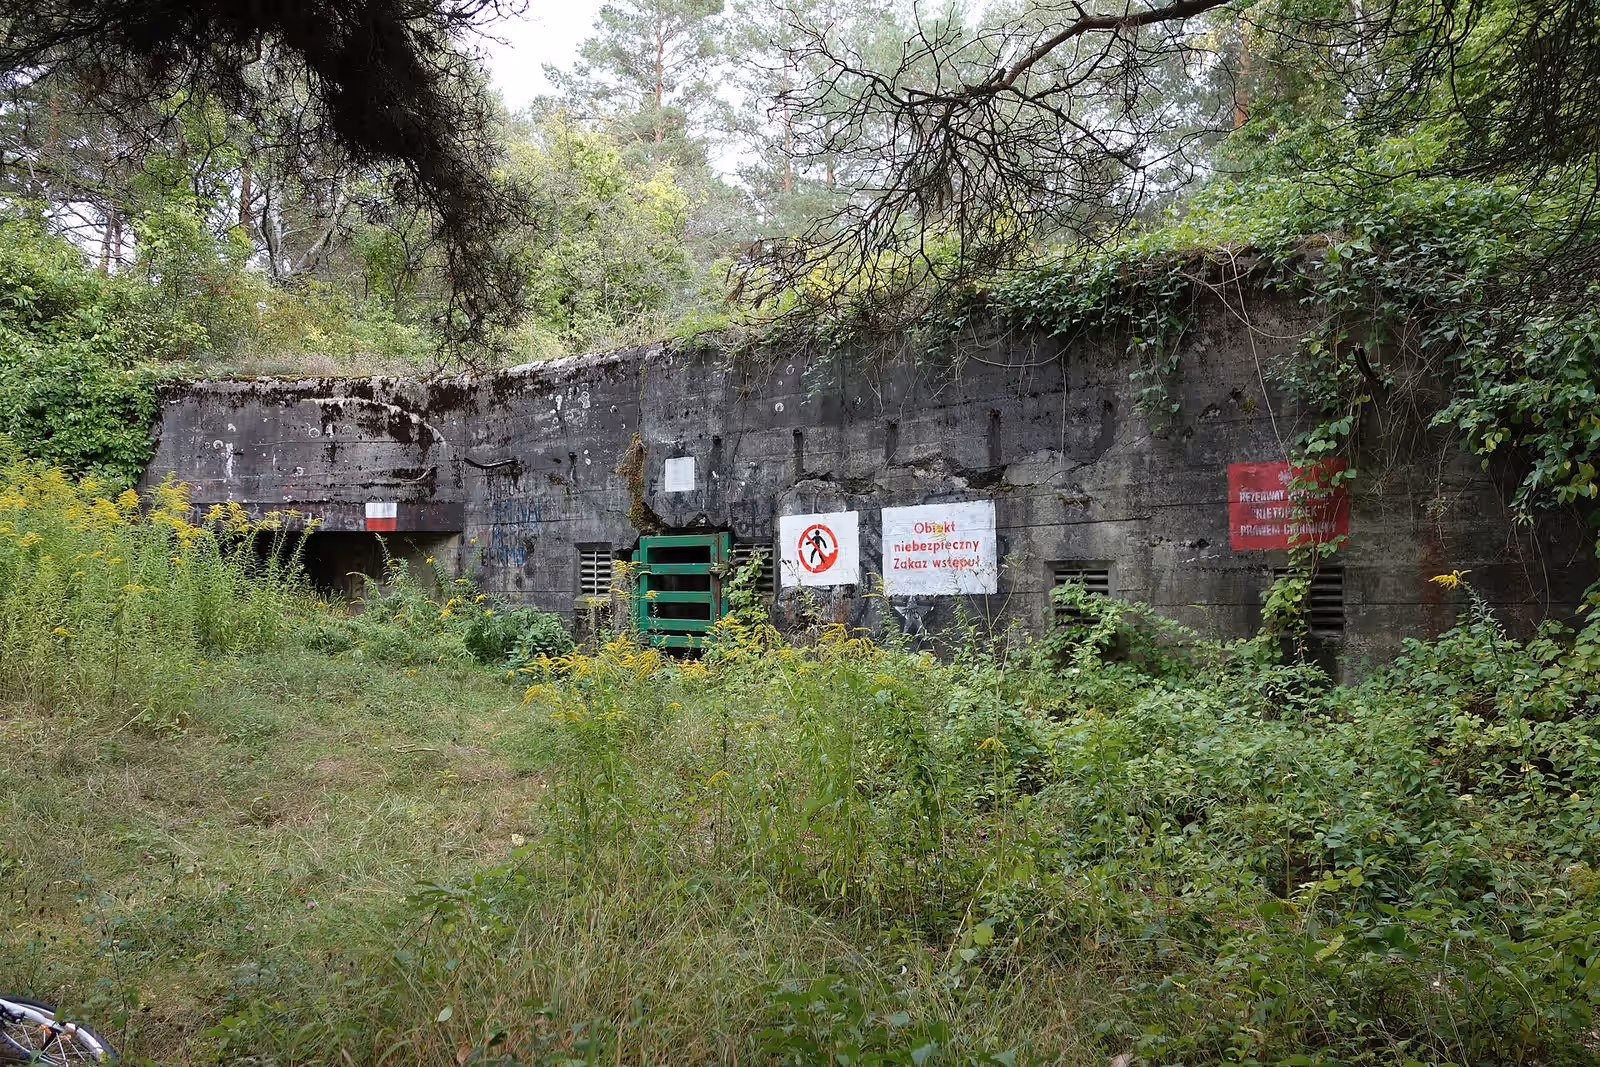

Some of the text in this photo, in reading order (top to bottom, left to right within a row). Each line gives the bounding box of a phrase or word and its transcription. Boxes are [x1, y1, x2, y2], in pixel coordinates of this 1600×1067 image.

[1239, 490, 1285, 503] REZERWAT
[914, 521, 956, 534] Obikt
[1240, 524, 1281, 537] PRAWEM
[894, 540, 979, 553] niebezpieczny
[893, 557, 928, 569] Zakaz
